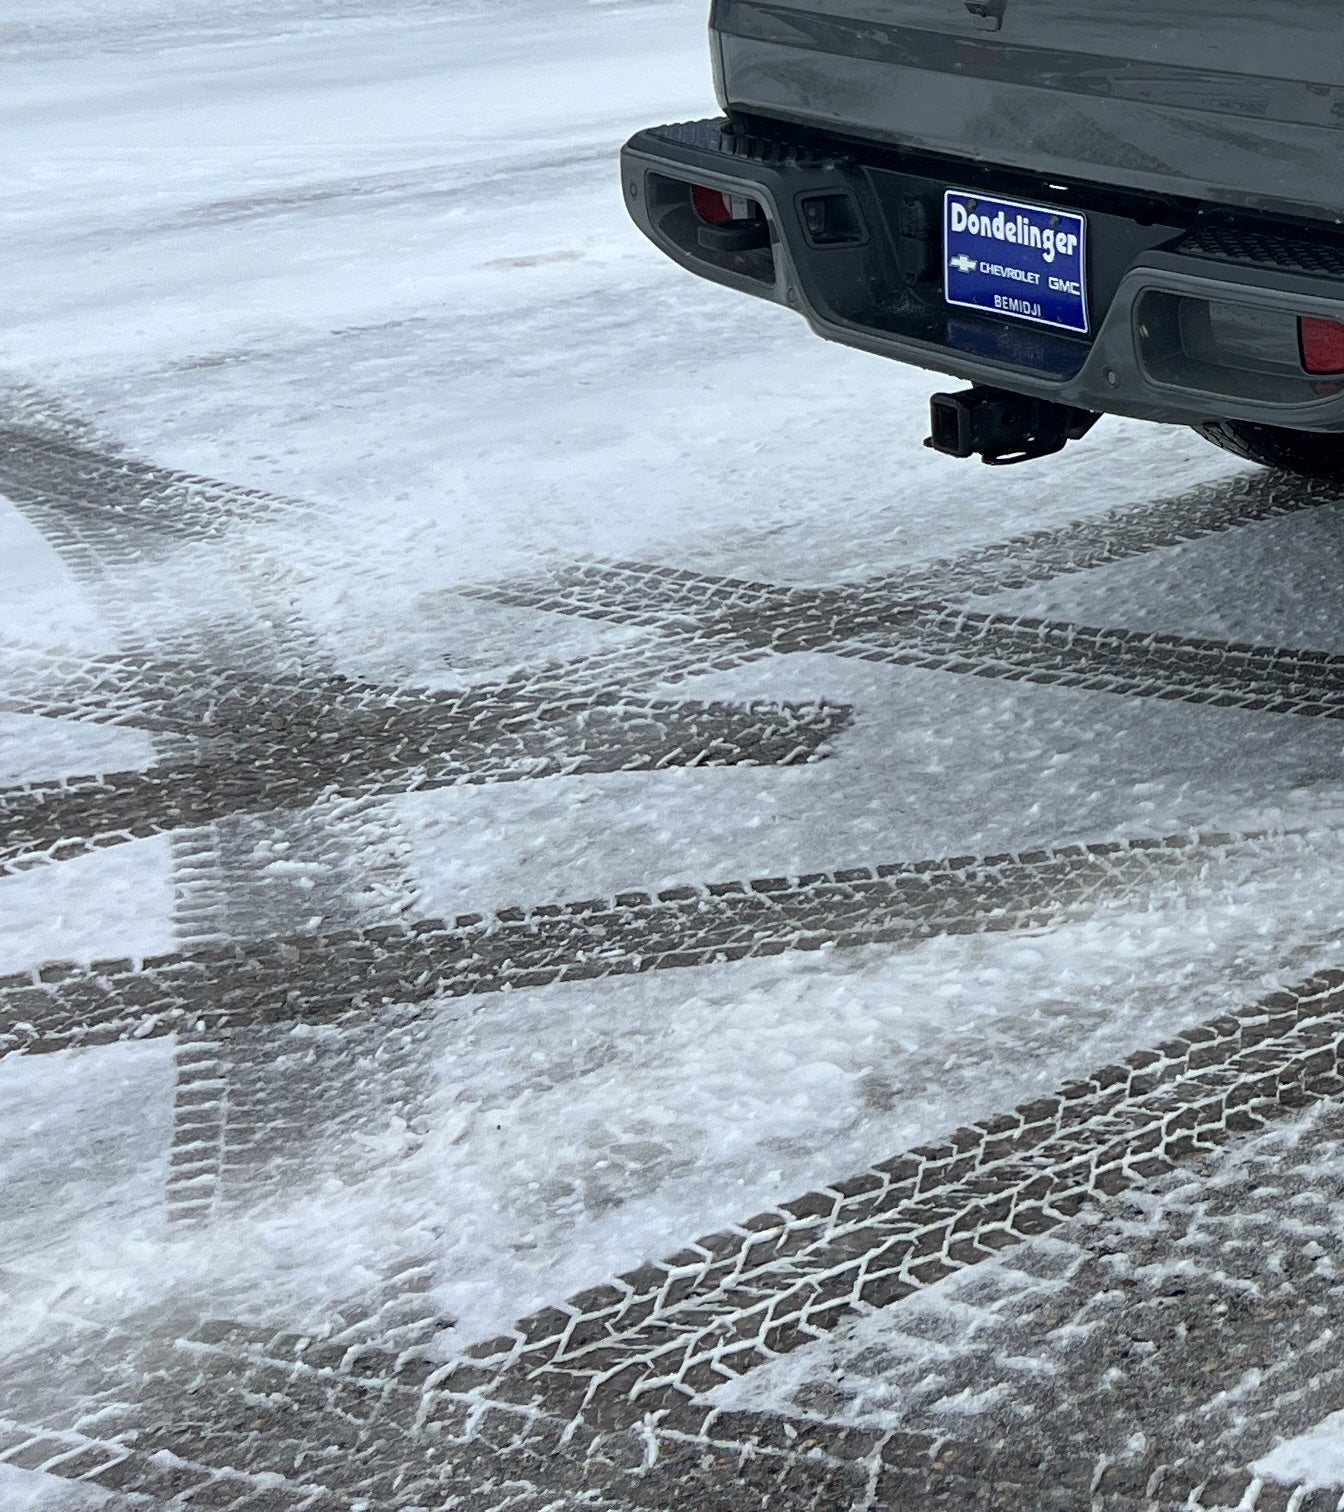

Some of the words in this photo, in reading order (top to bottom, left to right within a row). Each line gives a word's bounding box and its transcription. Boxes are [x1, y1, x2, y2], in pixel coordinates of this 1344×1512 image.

[950, 201, 1078, 263] Dondelinger
[979, 261, 1041, 285] CHEVROLET
[1048, 276, 1082, 296] GMC
[994, 294, 1042, 318] BEMIDJI
